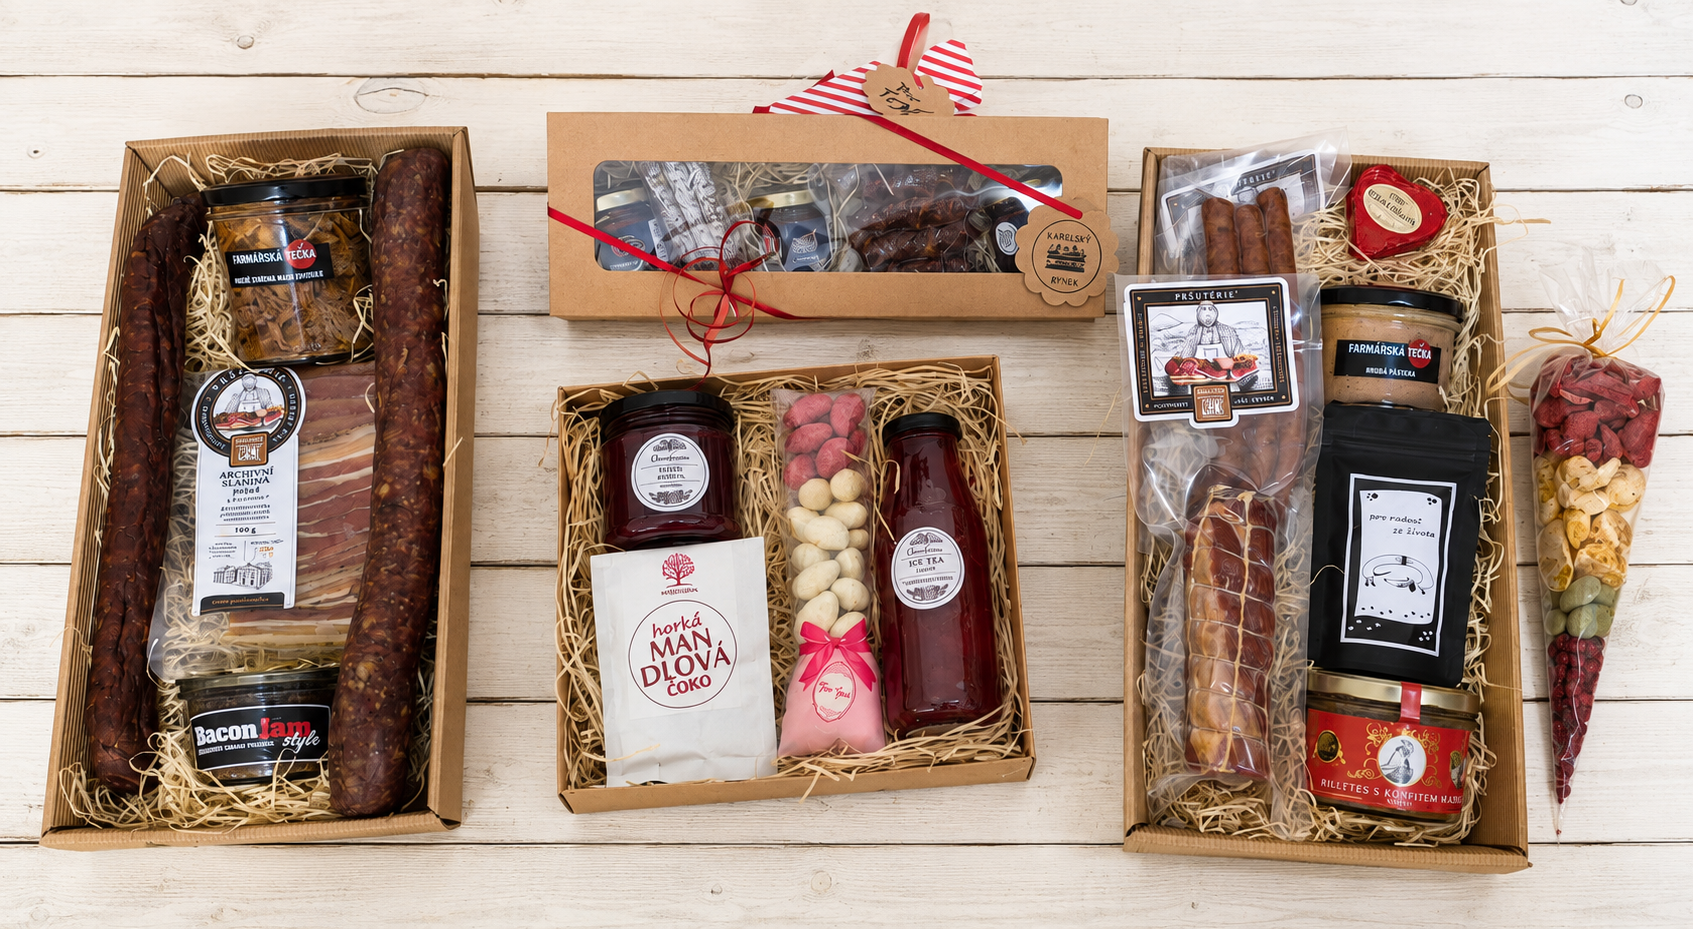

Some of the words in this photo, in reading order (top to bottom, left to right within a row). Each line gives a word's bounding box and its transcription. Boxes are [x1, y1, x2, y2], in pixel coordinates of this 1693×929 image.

[1047, 231, 1092, 244] KARELSKÝ
[286, 242, 317, 261] TEČKA
[1050, 275, 1079, 287] RYNEK
[1407, 342, 1432, 360] TEČKA
[219, 465, 274, 480] ARCHIVNÍ
[221, 475, 271, 488] SLANINA
[908, 558, 923, 568] ICE
[652, 611, 702, 638] horká
[649, 627, 713, 662] MAN
[640, 640, 731, 688] DLOVÁ
[666, 674, 712, 697] ČOKO
[194, 723, 259, 747] Bacon
[258, 717, 311, 740] Jam
[282, 729, 321, 754] style
[1320, 778, 1370, 795] RILLETES
[1373, 787, 1380, 796] S
[1384, 788, 1438, 803] KONFITEM
